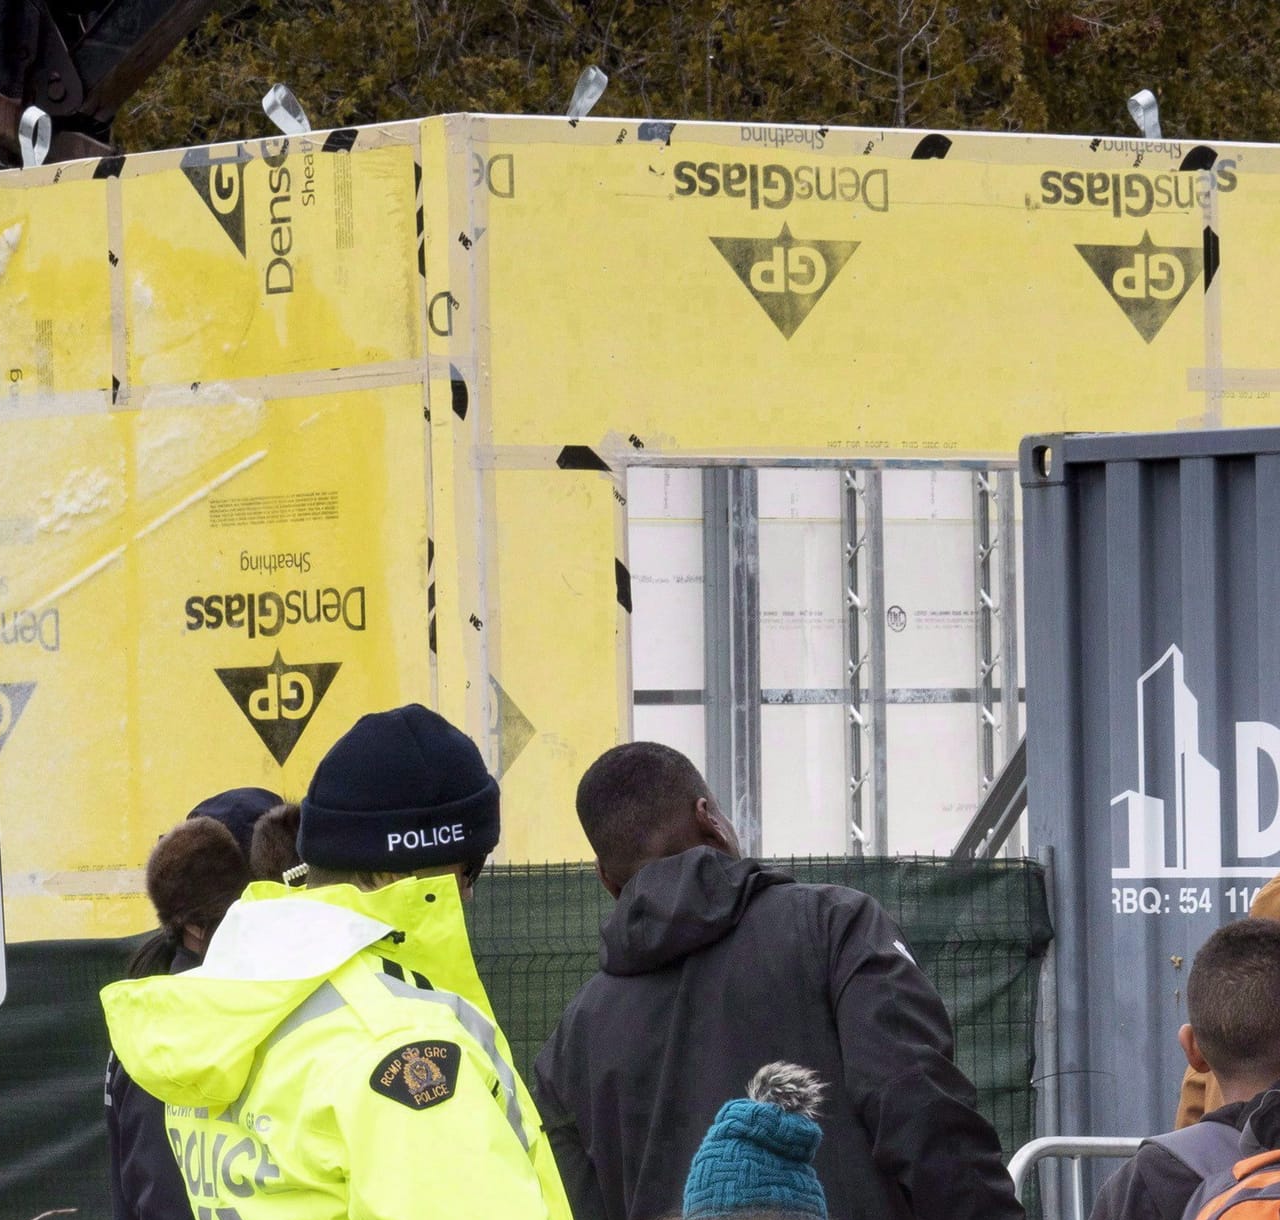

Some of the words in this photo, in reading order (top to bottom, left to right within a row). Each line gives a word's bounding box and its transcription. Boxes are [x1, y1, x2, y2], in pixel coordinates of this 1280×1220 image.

[673, 161, 889, 213] DensGlass
[749, 246, 827, 295] GP
[1112, 253, 1185, 299] GP
[240, 551, 311, 575] Sheathing
[185, 587, 366, 638] DensGlass
[249, 671, 314, 720] GP
[387, 823, 466, 852] POLICE
[424, 1047, 447, 1059] GRC
[380, 1059, 402, 1087] RCMP
[414, 1084, 450, 1105] POLICE
